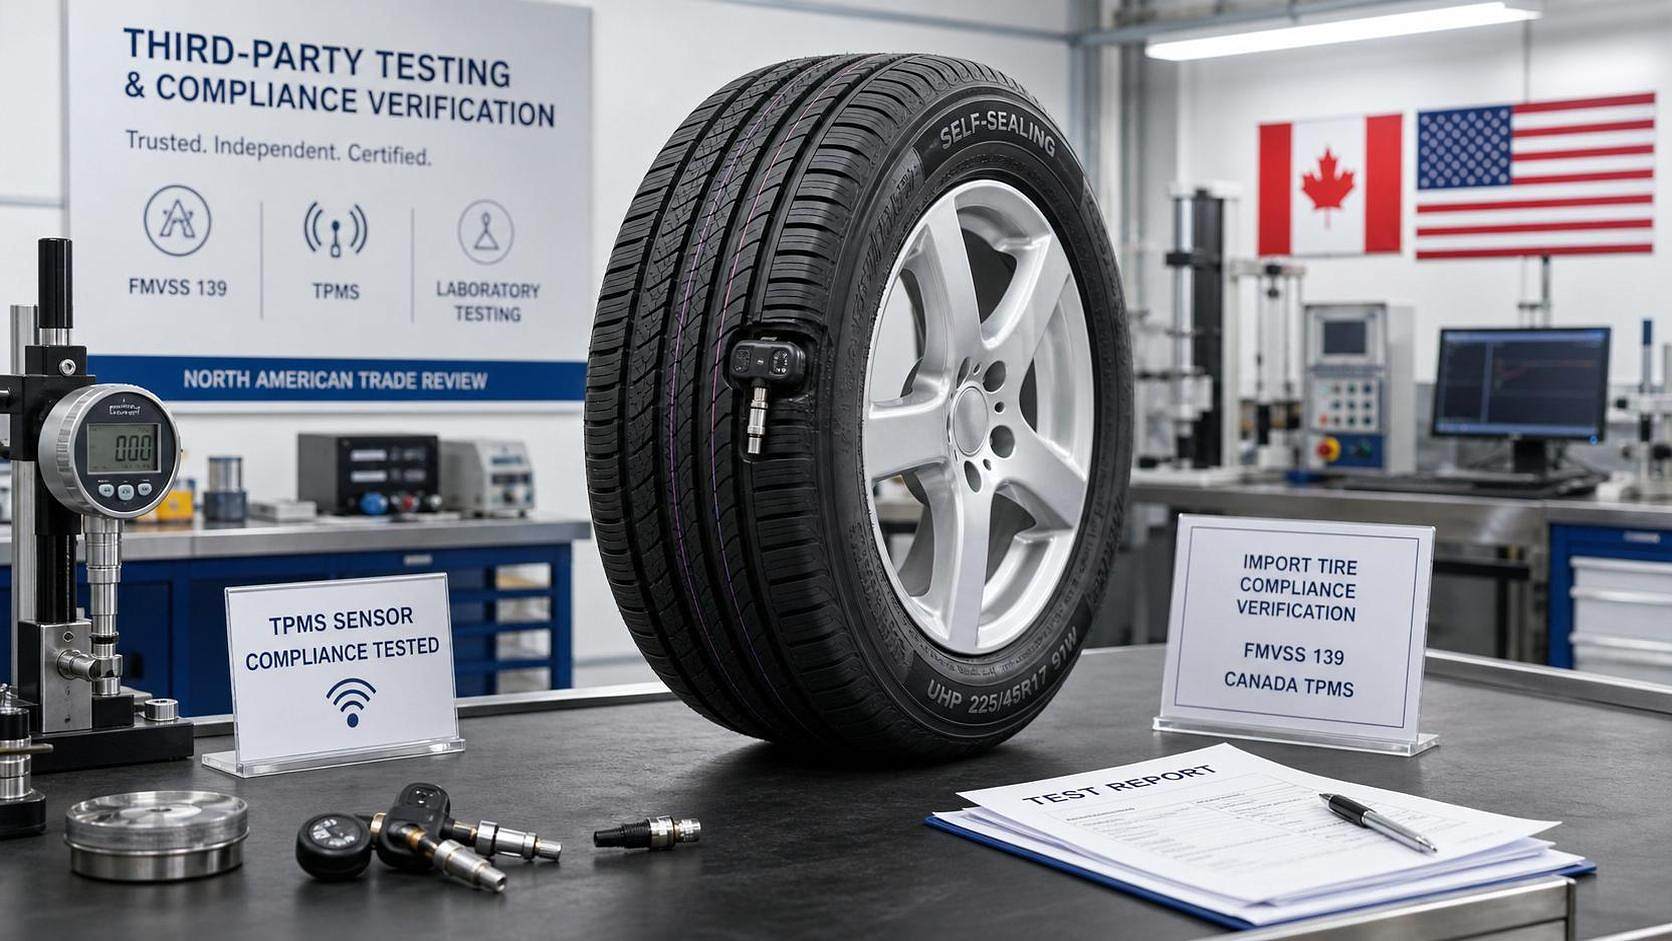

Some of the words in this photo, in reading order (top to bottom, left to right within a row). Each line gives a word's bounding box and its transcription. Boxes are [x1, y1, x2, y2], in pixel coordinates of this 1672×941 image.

[123, 28, 363, 76] THIRD-PARTY
[376, 50, 511, 88] TESTING
[125, 72, 145, 98] &
[156, 74, 357, 113] COMPLIANCE
[368, 91, 555, 127] VERIFICATION
[940, 110, 1056, 157] SELF-SEALING
[126, 130, 207, 154] Trusted.
[214, 135, 341, 162] Independent.
[348, 143, 432, 167] Certified.
[129, 279, 190, 295] FMVSS
[197, 280, 227, 297] 139
[312, 283, 360, 300] TPMS
[436, 281, 540, 299] LABORATORY
[454, 306, 521, 323] TESTING
[184, 370, 250, 389] NORTH
[255, 371, 355, 389] AMERICAN
[358, 371, 418, 390] TRADE
[422, 372, 488, 390] REVIEW
[1243, 554, 1312, 573] IMPORT
[1318, 558, 1358, 576] TIRE
[1240, 577, 1356, 599] COMPLIANCE
[269, 613, 327, 636] TPMS
[333, 606, 413, 631] SENSOR
[1236, 600, 1356, 622] VERIFICATION
[245, 642, 369, 671] COMPLIANCE
[372, 637, 440, 658] TESTED
[1244, 642, 1306, 662] FMVSS
[1314, 649, 1345, 665] 139
[927, 679, 962, 709] UHP
[968, 665, 1047, 714] 225/45R17
[1051, 626, 1078, 670] 91W
[1224, 671, 1298, 693] CANADA
[1305, 678, 1354, 698] TPMS
[1022, 786, 1100, 805] TEST
[1105, 764, 1217, 792] REPORT
